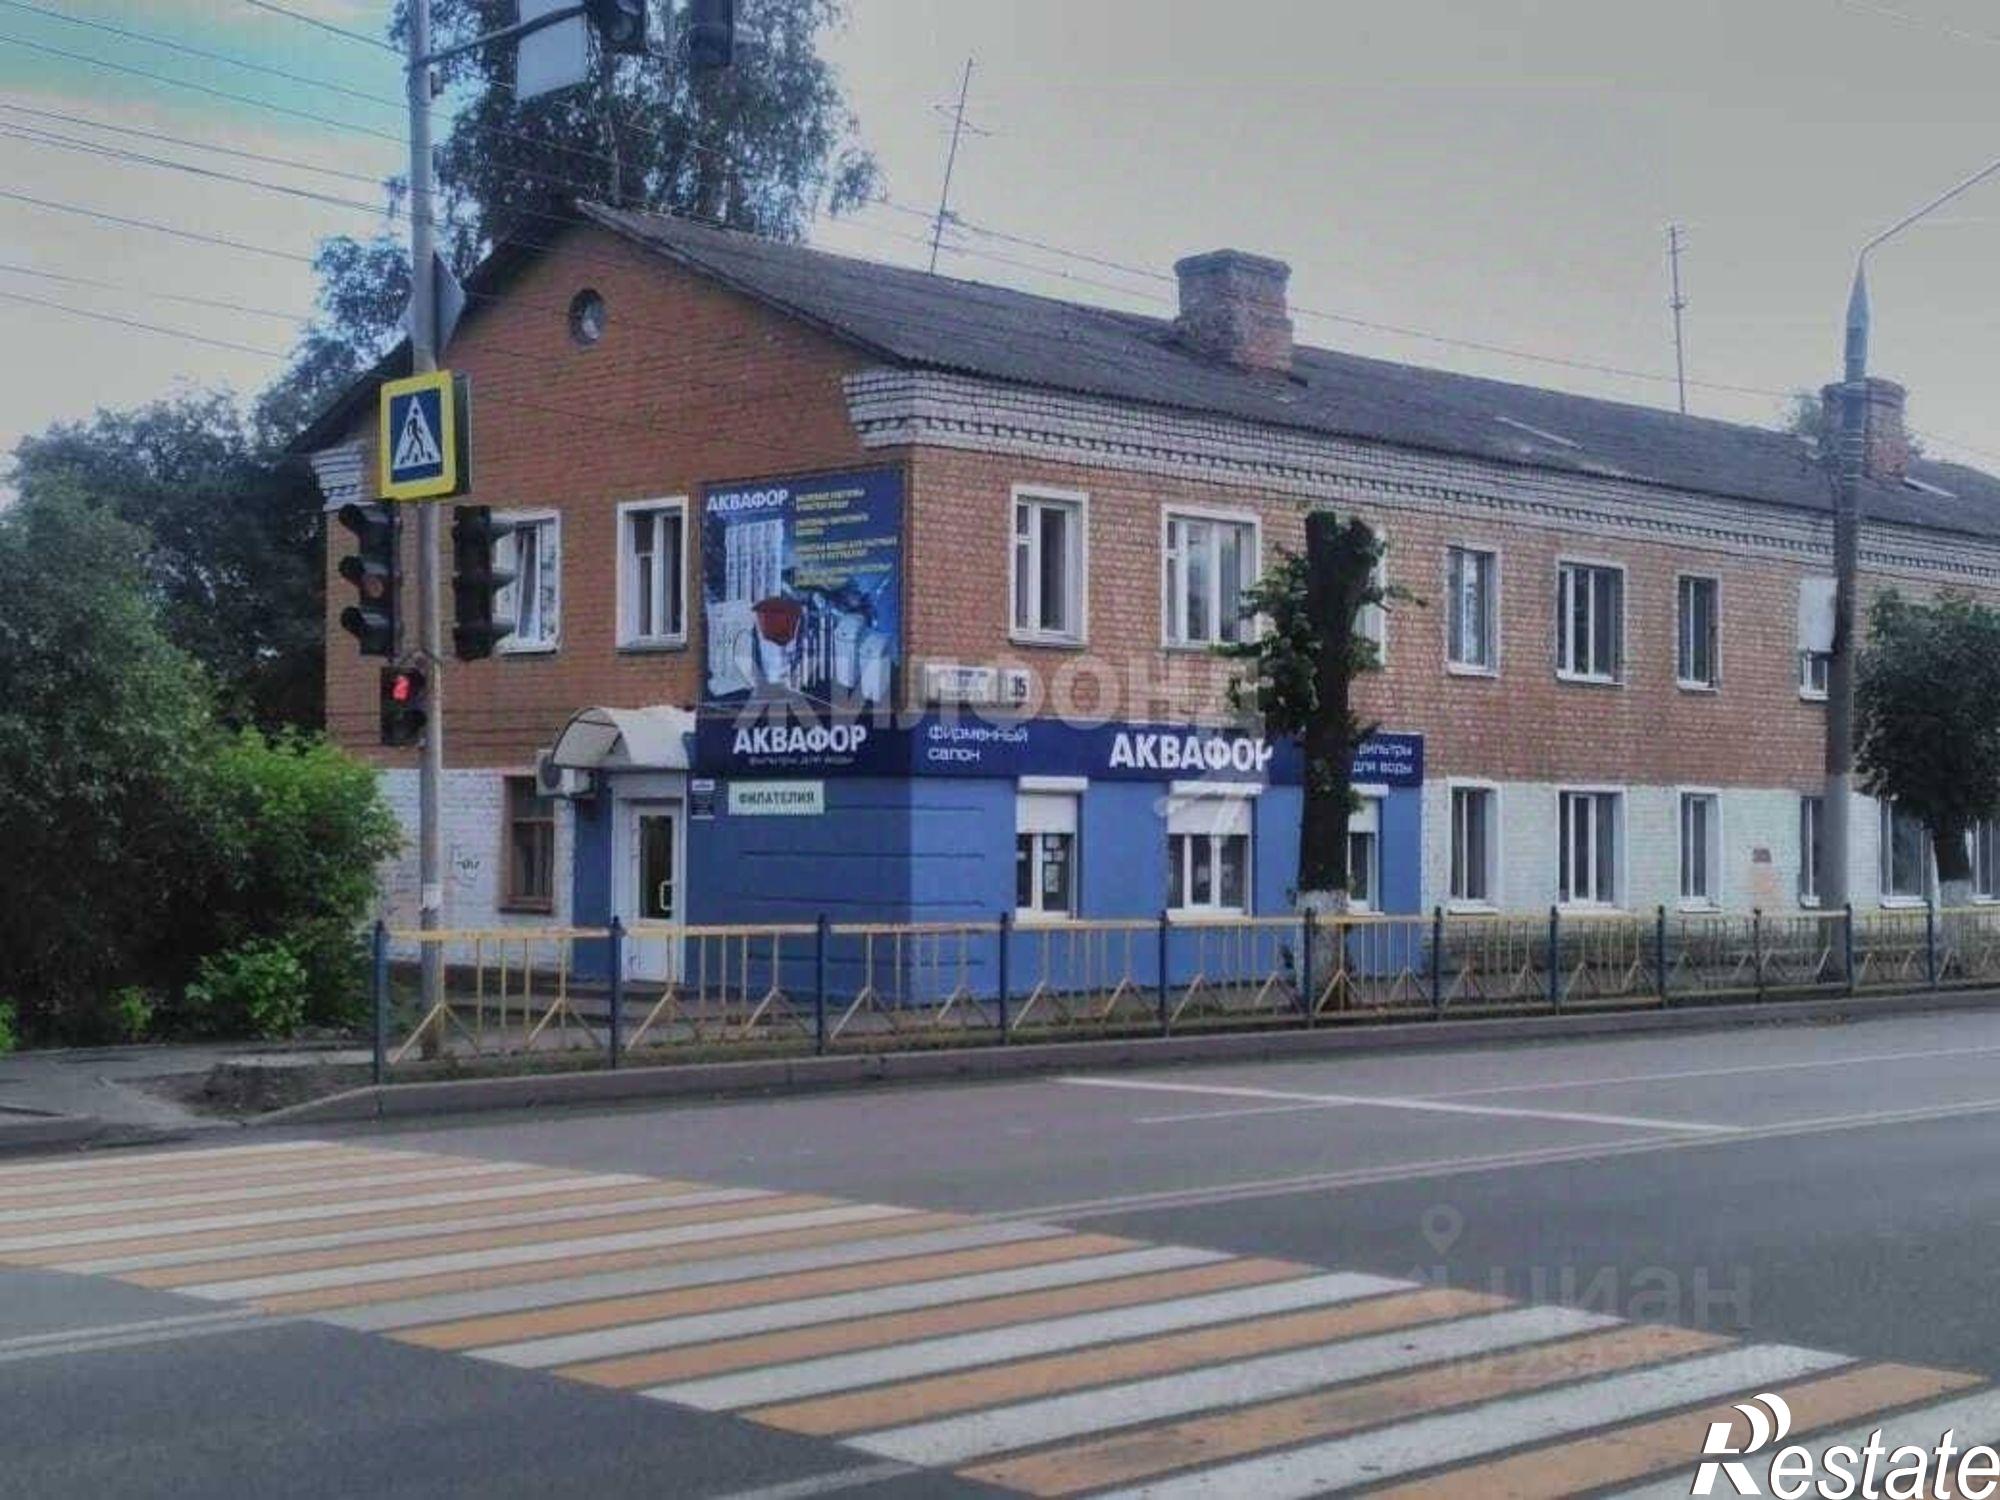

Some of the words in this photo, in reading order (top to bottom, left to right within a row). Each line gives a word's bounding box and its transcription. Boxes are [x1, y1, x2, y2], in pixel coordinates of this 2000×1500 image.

[706, 488, 789, 512] АКВАФОР
[732, 725, 867, 754] АКВАФОР
[928, 724, 1029, 743] фирменный
[927, 747, 980, 762] салон
[1109, 732, 1274, 772] АКВАФОР
[738, 791, 815, 805] ФИЛАТЕЛИЯ
